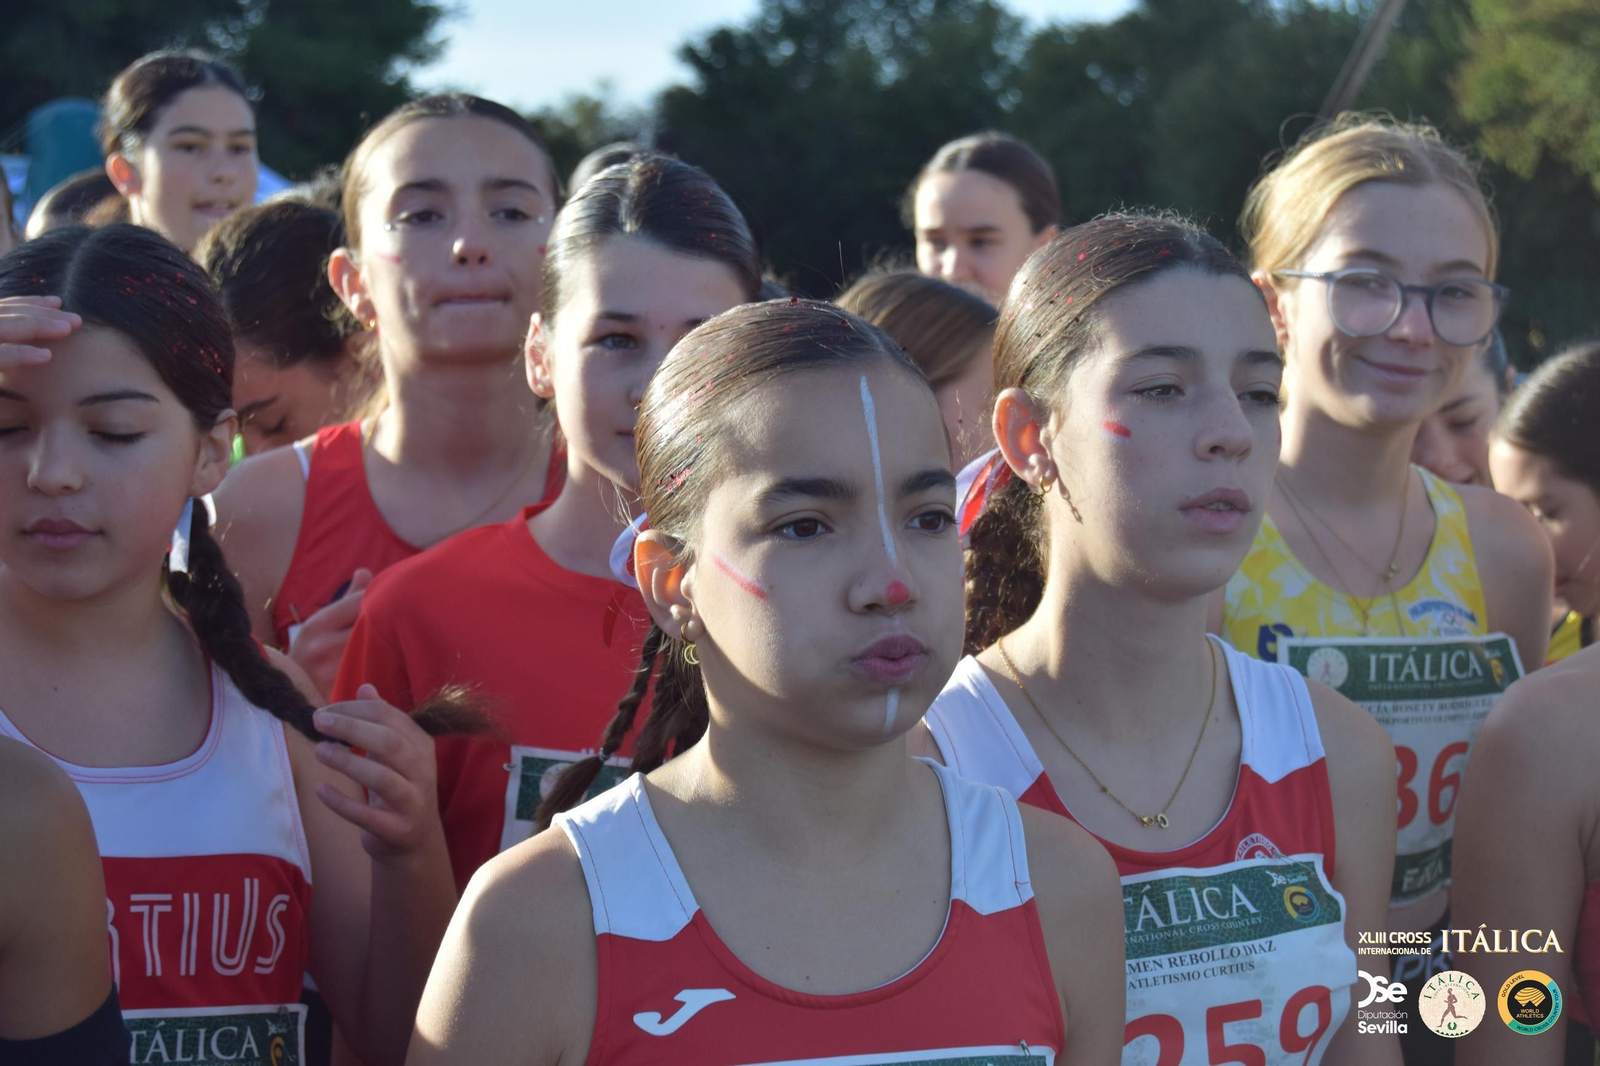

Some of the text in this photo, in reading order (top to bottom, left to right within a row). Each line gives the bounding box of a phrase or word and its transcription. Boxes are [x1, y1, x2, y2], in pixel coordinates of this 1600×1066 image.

[1369, 647, 1482, 681] ITÁLICA
[1189, 922, 1220, 934] CROSS
[1221, 916, 1263, 929] COUNTRY
[1126, 959, 1163, 976] MEN
[1167, 946, 1241, 969] REBOLLO
[1128, 961, 1255, 990] ATLETISMO CURTIUS
